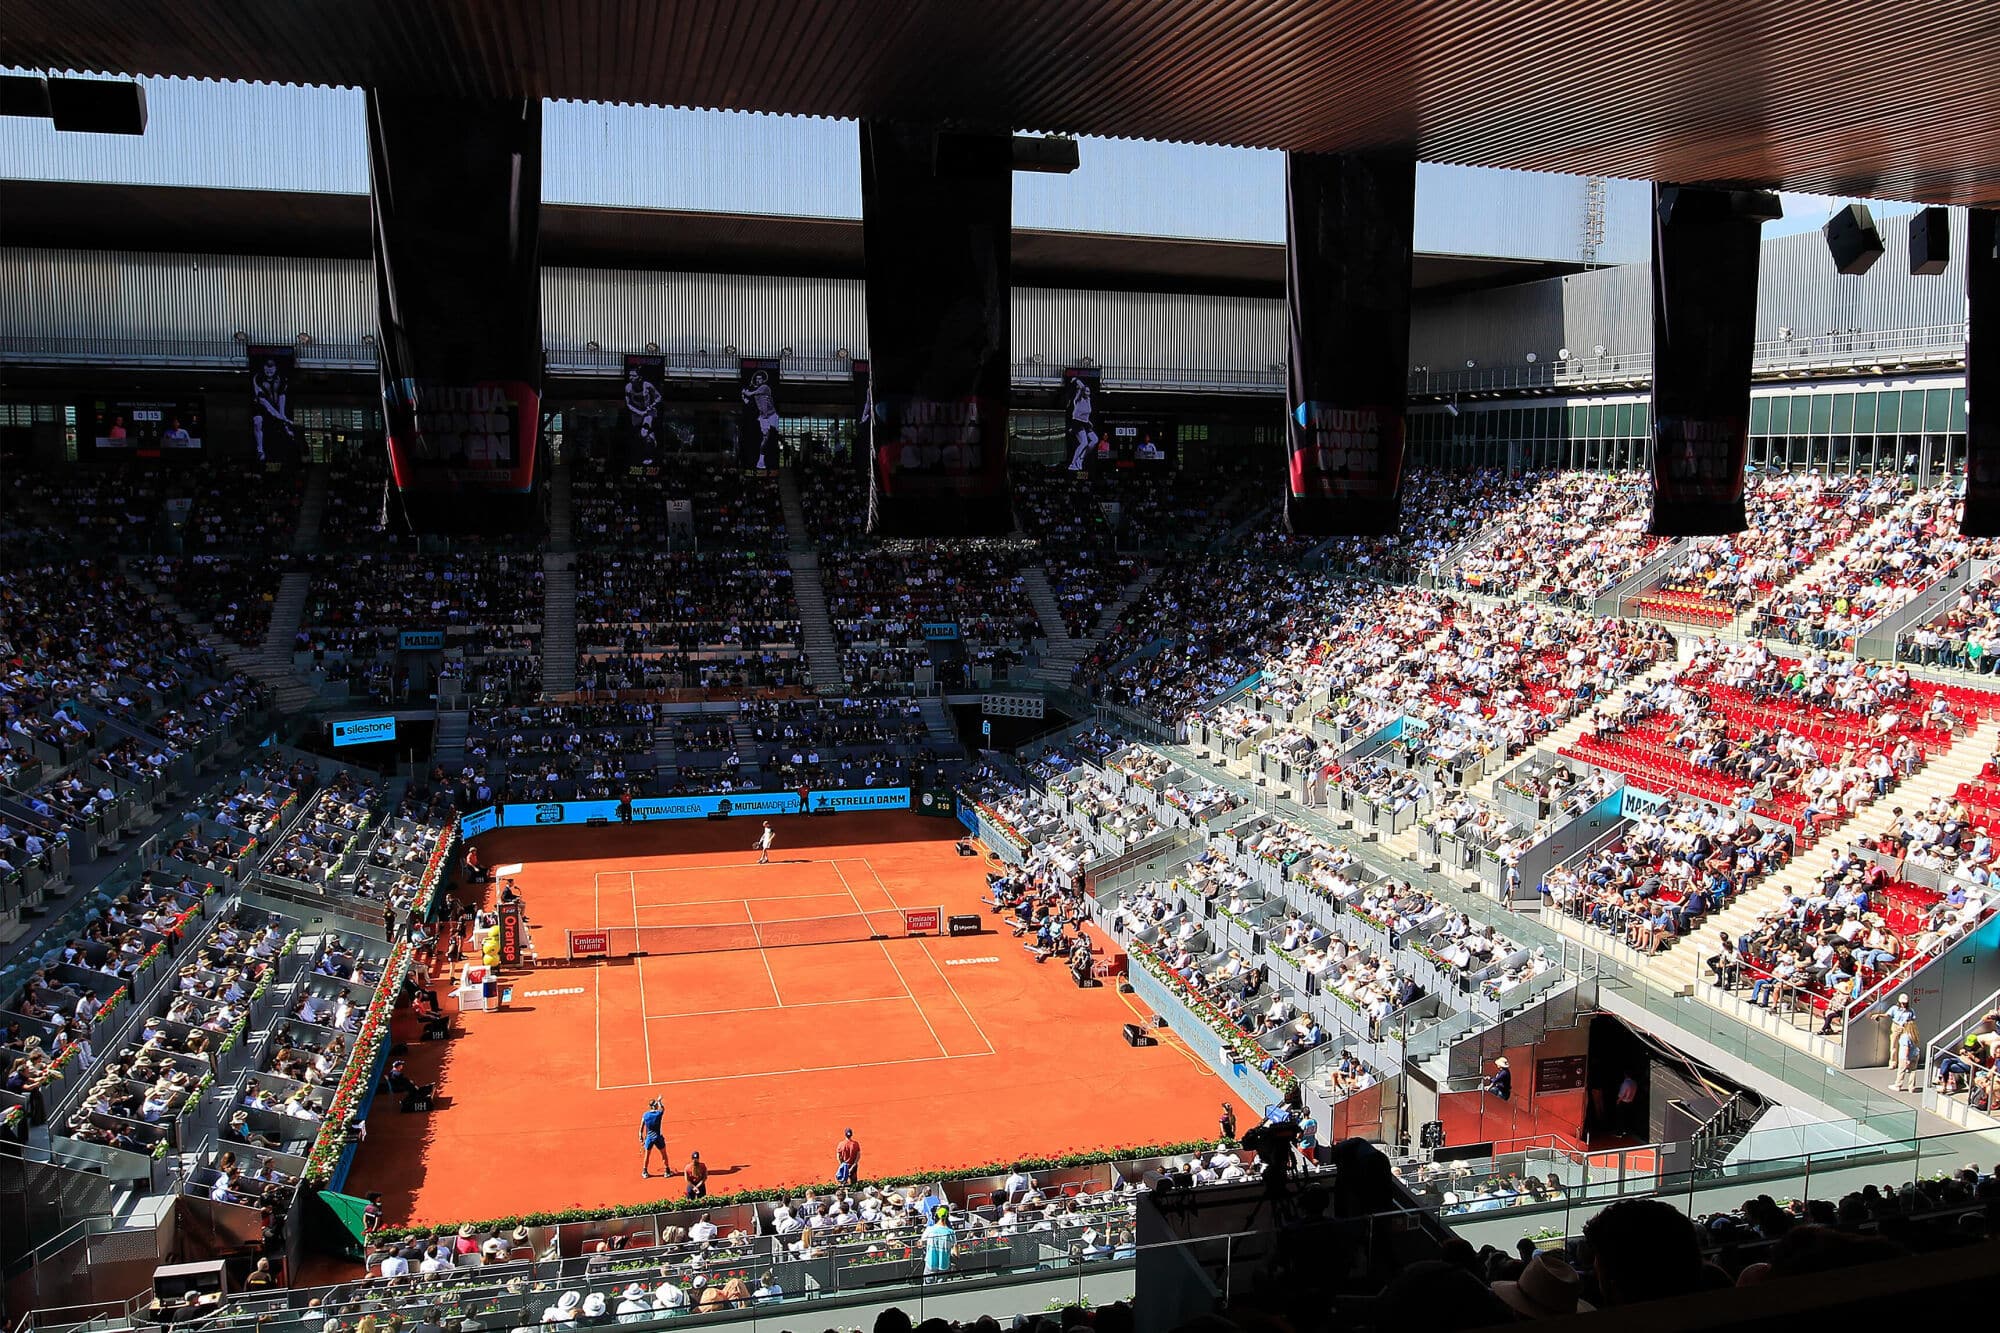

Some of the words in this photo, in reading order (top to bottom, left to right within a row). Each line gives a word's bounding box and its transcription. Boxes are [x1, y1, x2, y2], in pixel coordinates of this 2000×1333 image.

[1315, 409, 1378, 431] MUTUA
[347, 722, 392, 734] silestone
[831, 797, 874, 806] ESTRELLA
[876, 795, 905, 804] DAMM
[504, 916, 517, 961] Orange
[945, 957, 1000, 965] MADRID
[524, 987, 585, 997] MADRID
